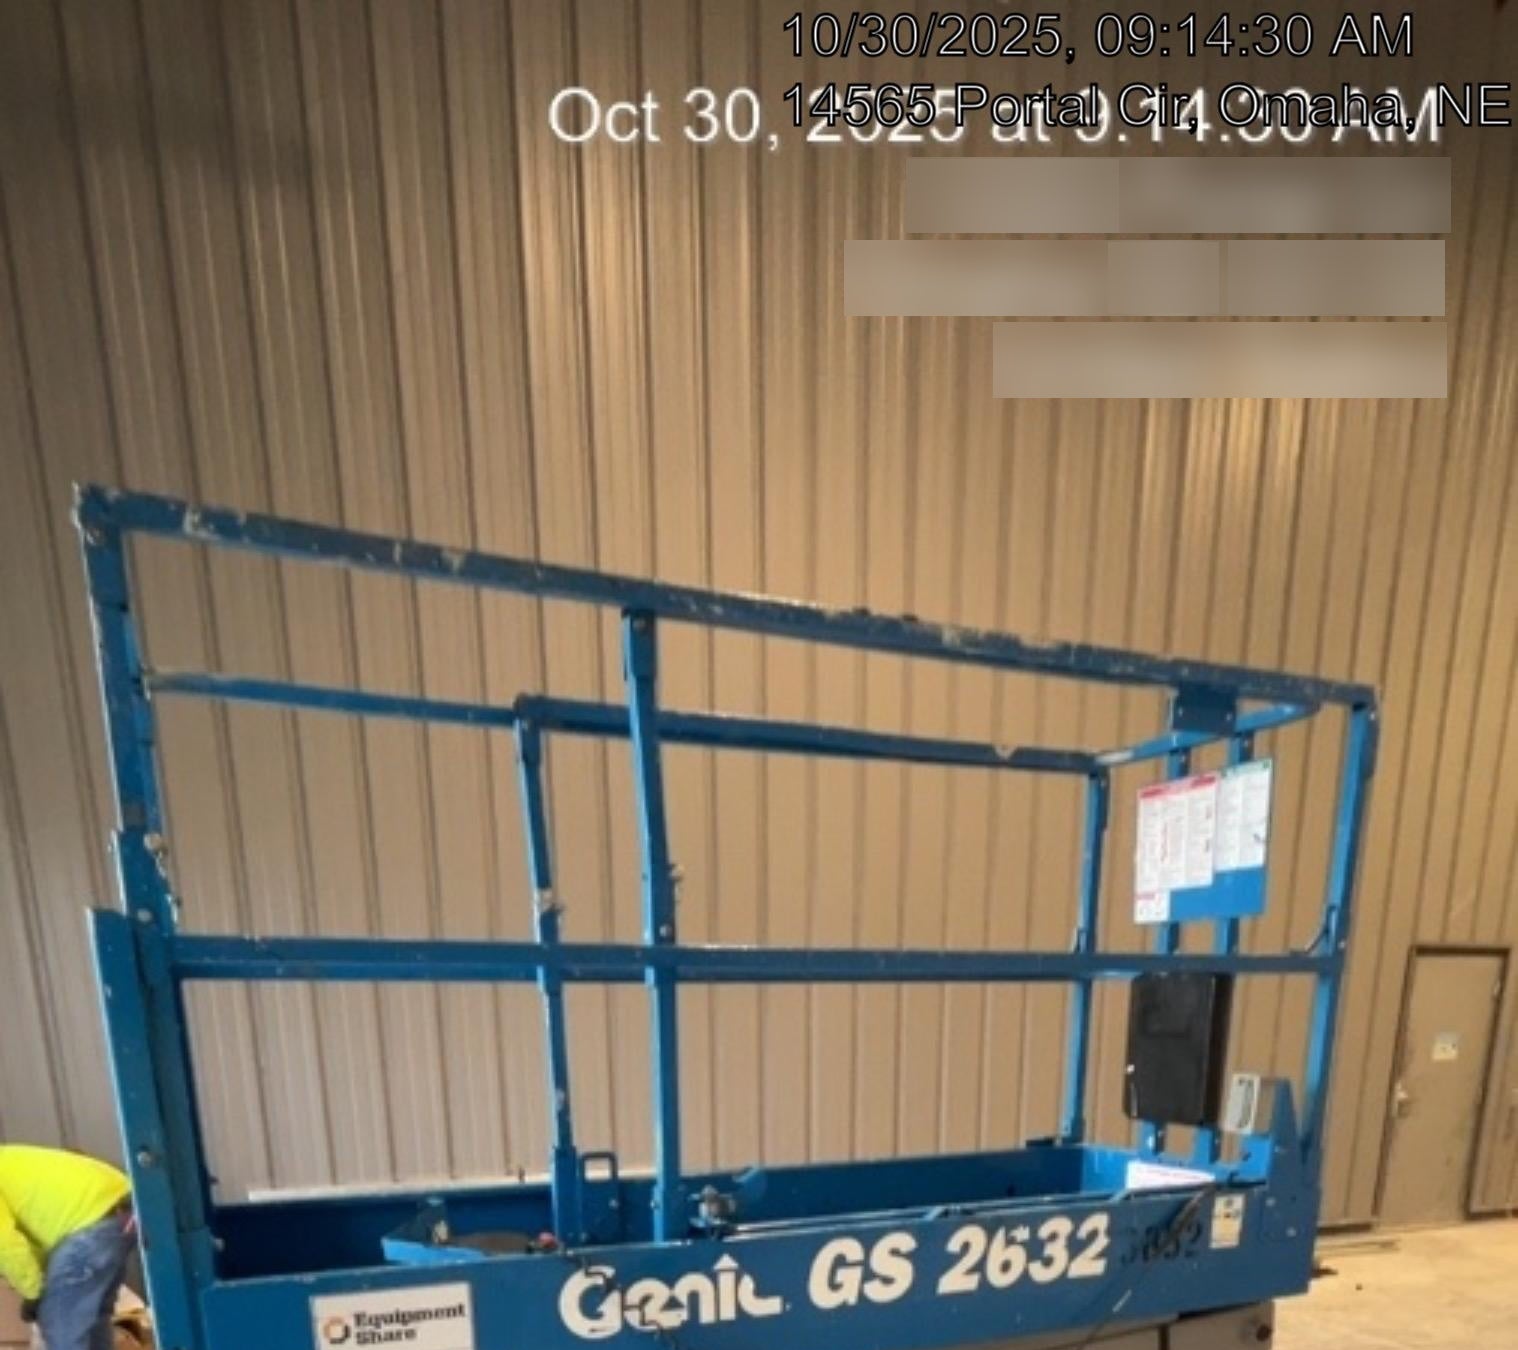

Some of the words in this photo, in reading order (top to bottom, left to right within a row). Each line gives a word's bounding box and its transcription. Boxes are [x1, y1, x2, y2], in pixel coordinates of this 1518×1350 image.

[808, 1231, 918, 1309] GS
[937, 1212, 1110, 1295] 2632
[353, 1303, 466, 1329] Equipment
[355, 1328, 417, 1346] Share
